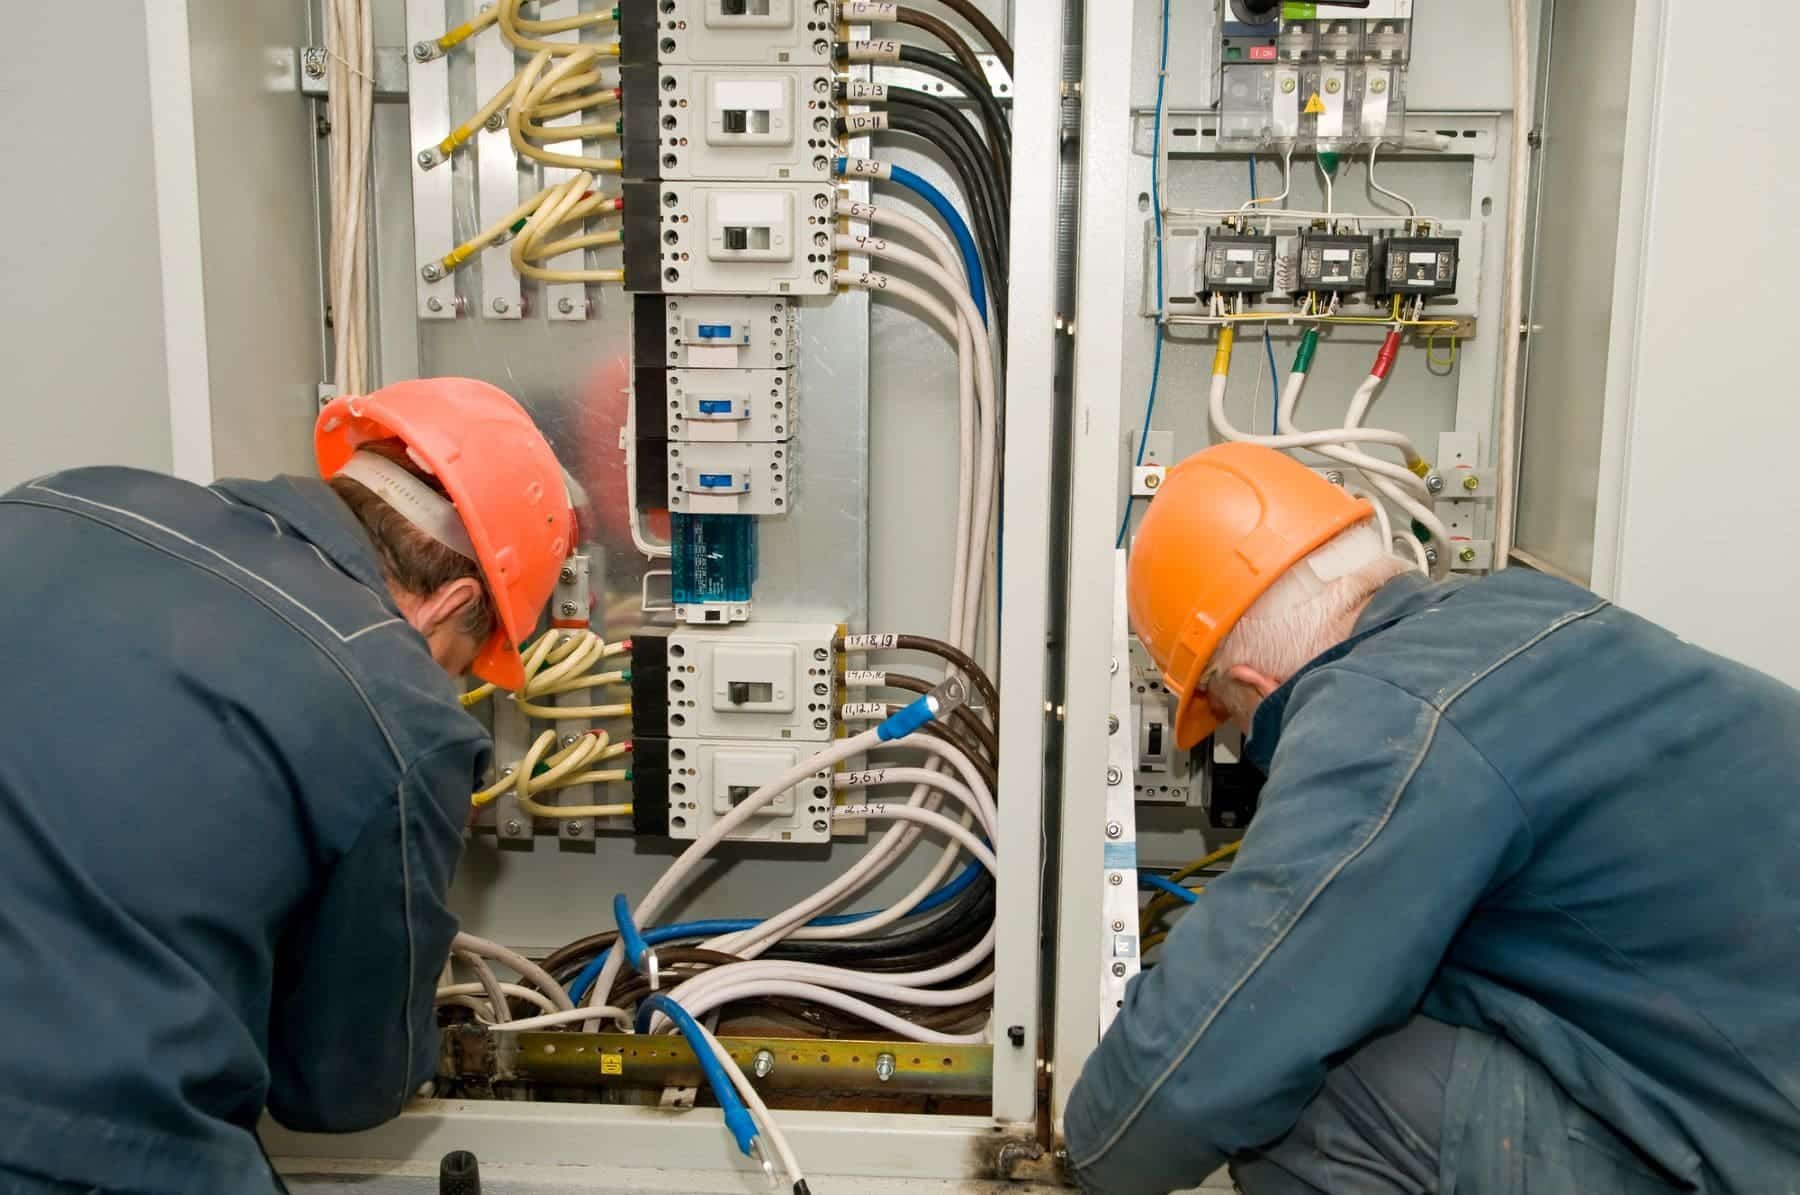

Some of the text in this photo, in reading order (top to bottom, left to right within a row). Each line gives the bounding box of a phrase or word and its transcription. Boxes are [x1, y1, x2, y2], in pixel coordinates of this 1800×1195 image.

[852, 84, 883, 97] 12-13
[852, 116, 881, 129] 10-11
[855, 159, 880, 174] 8-9
[850, 203, 877, 219] 6-7
[860, 273, 888, 289] 2-3
